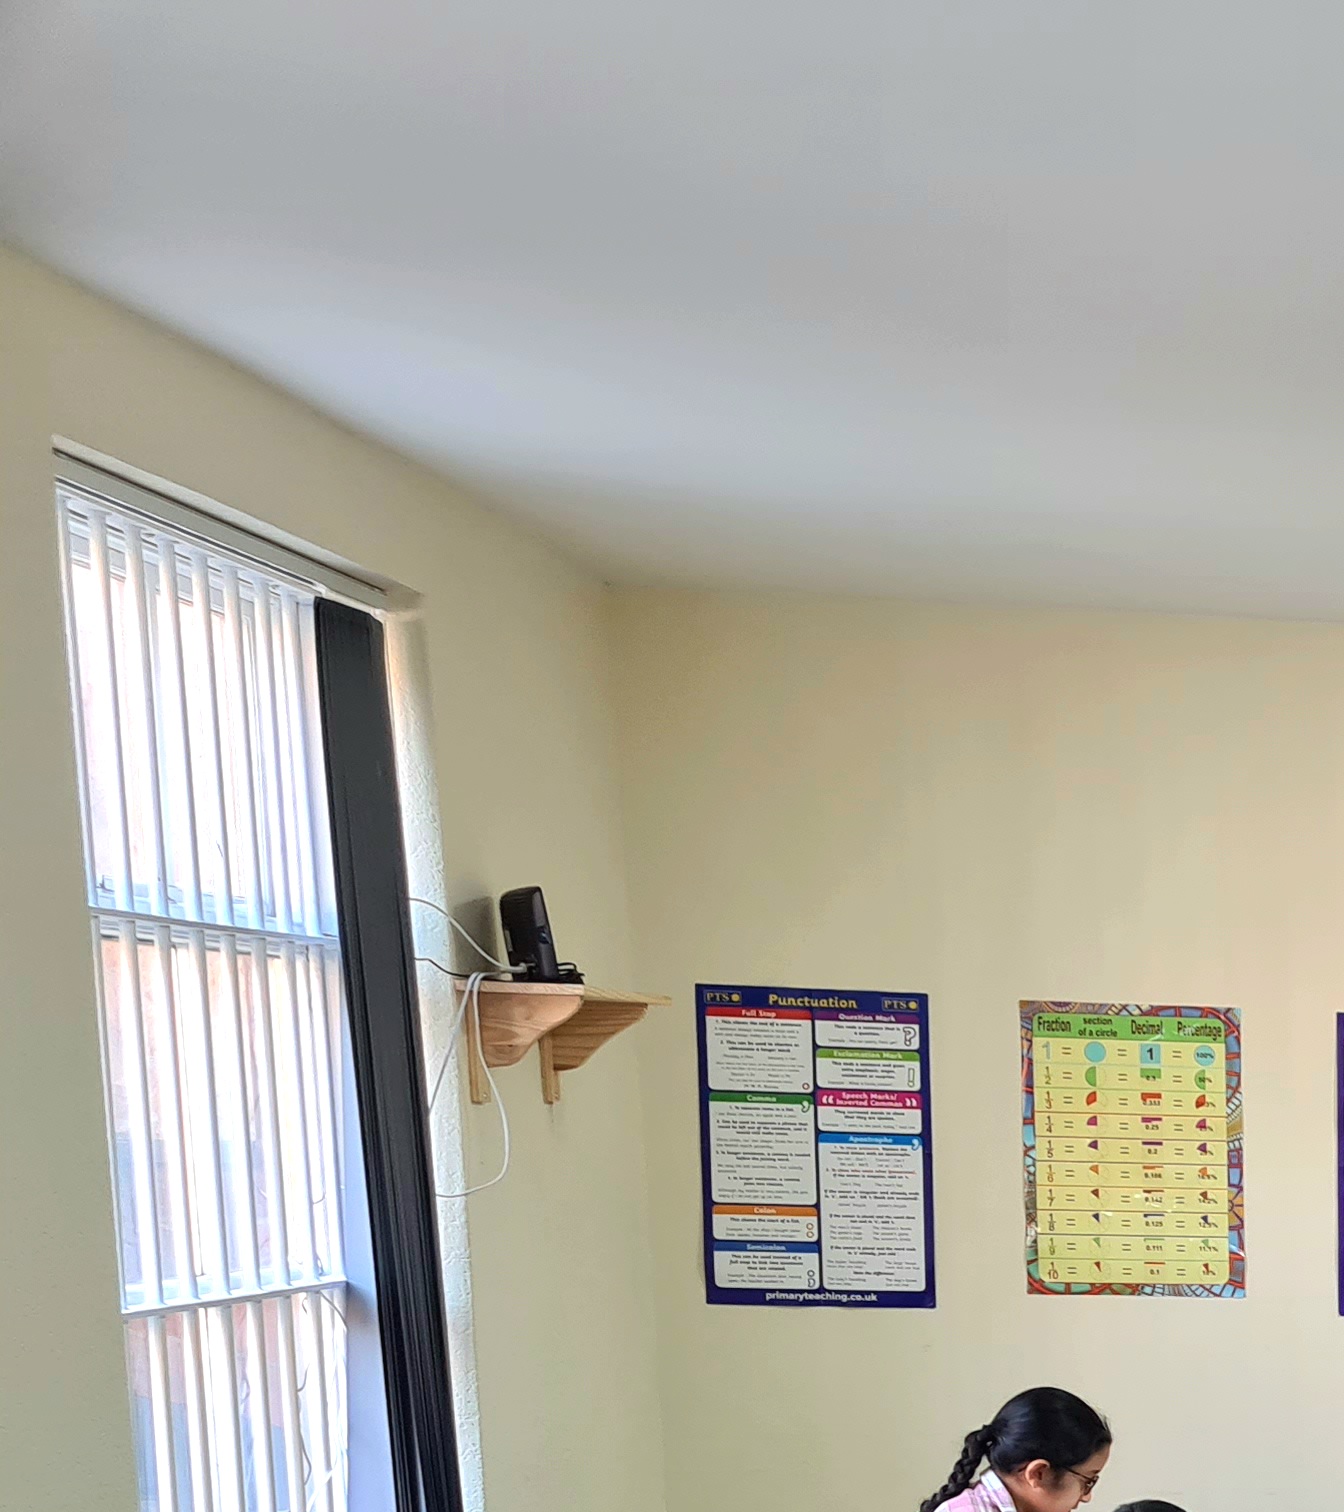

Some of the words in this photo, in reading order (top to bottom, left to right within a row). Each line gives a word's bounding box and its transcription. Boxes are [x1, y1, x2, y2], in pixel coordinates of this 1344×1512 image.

[768, 993, 858, 1009] Punctuation
[884, 999, 907, 1010] PTS
[1037, 1015, 1071, 1033] Fraction
[1083, 1017, 1113, 1026] section
[1130, 1019, 1164, 1036] Decimal
[1078, 1027, 1087, 1036] of
[1095, 1028, 1118, 1037] circle
[1177, 1021, 1222, 1041] Percentage
[1146, 1047, 1154, 1061] 1
[841, 1091, 868, 1101] Speech
[1047, 1270, 1059, 1280] 10
[765, 1290, 878, 1303] primaryteaching.co.uk
